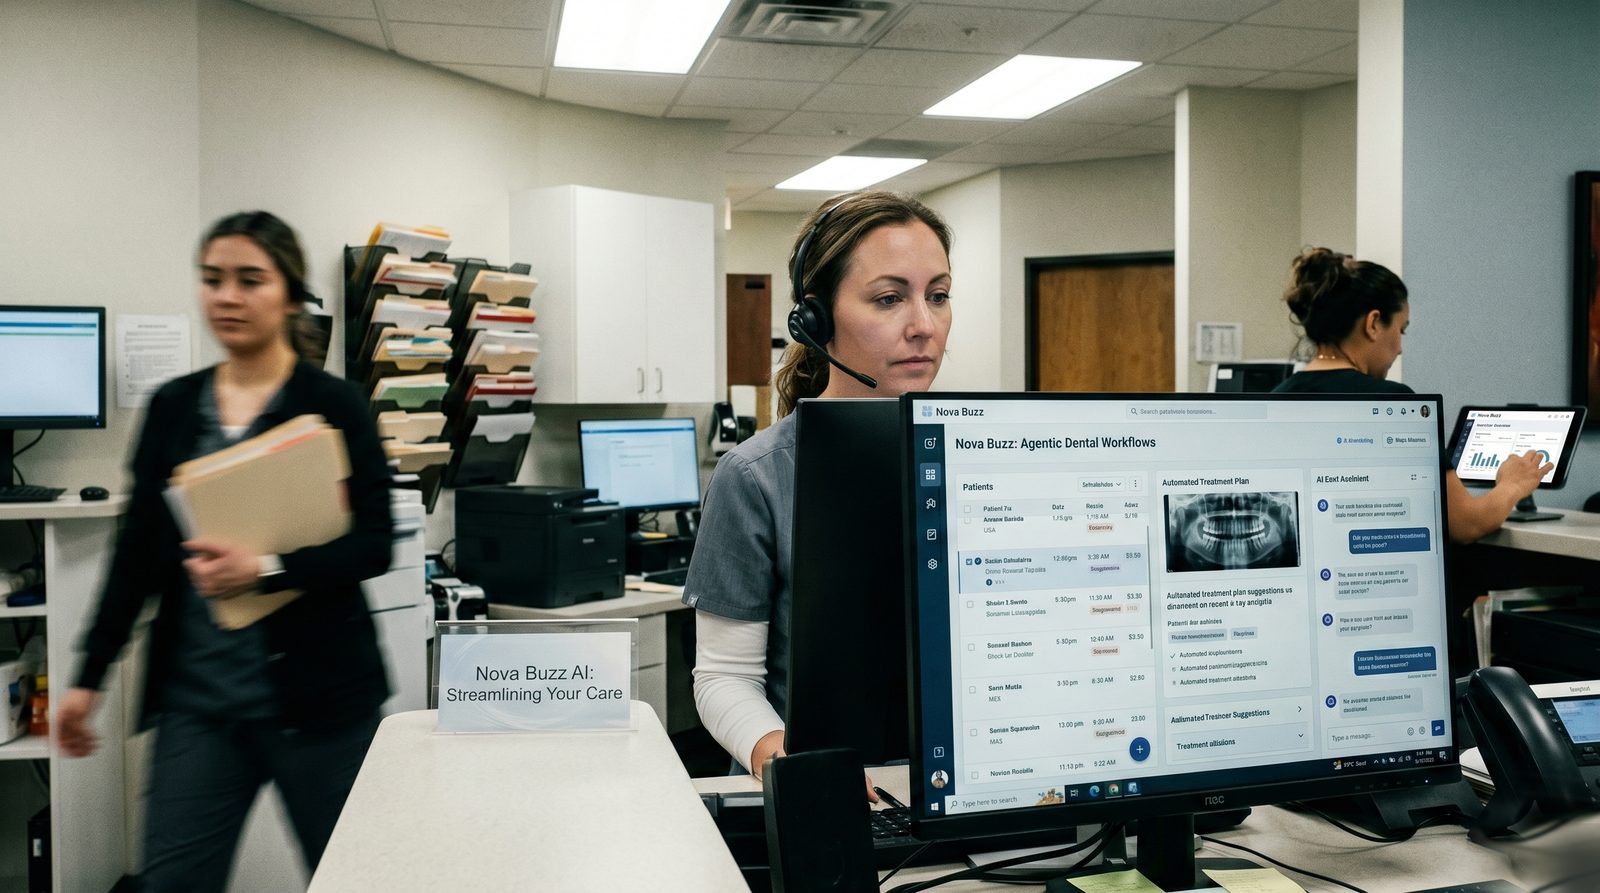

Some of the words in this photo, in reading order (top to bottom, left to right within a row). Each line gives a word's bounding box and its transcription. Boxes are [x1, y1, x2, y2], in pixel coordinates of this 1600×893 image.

[936, 407, 959, 417] Nova
[962, 407, 984, 417] Buzz
[955, 439, 984, 450] Nova
[987, 438, 1018, 449] Buzz:
[1021, 438, 1062, 452] Agentic
[1065, 436, 1099, 448] Dental
[1101, 436, 1156, 448] Workflows
[962, 482, 994, 491] Patients
[1162, 478, 1199, 486] Automated
[1200, 478, 1234, 486] Treatment
[1235, 477, 1250, 485] Plan
[1202, 590, 1232, 598] treatment
[1232, 588, 1246, 597] plan
[1247, 587, 1284, 596] suggestions
[476, 666, 520, 681] Nova
[526, 665, 567, 680] Buzz
[571, 664, 594, 680] AI:
[446, 687, 542, 704] Streamlining
[546, 686, 582, 700] Your
[586, 686, 623, 700] Care
[1232, 709, 1270, 719] Suggestions
